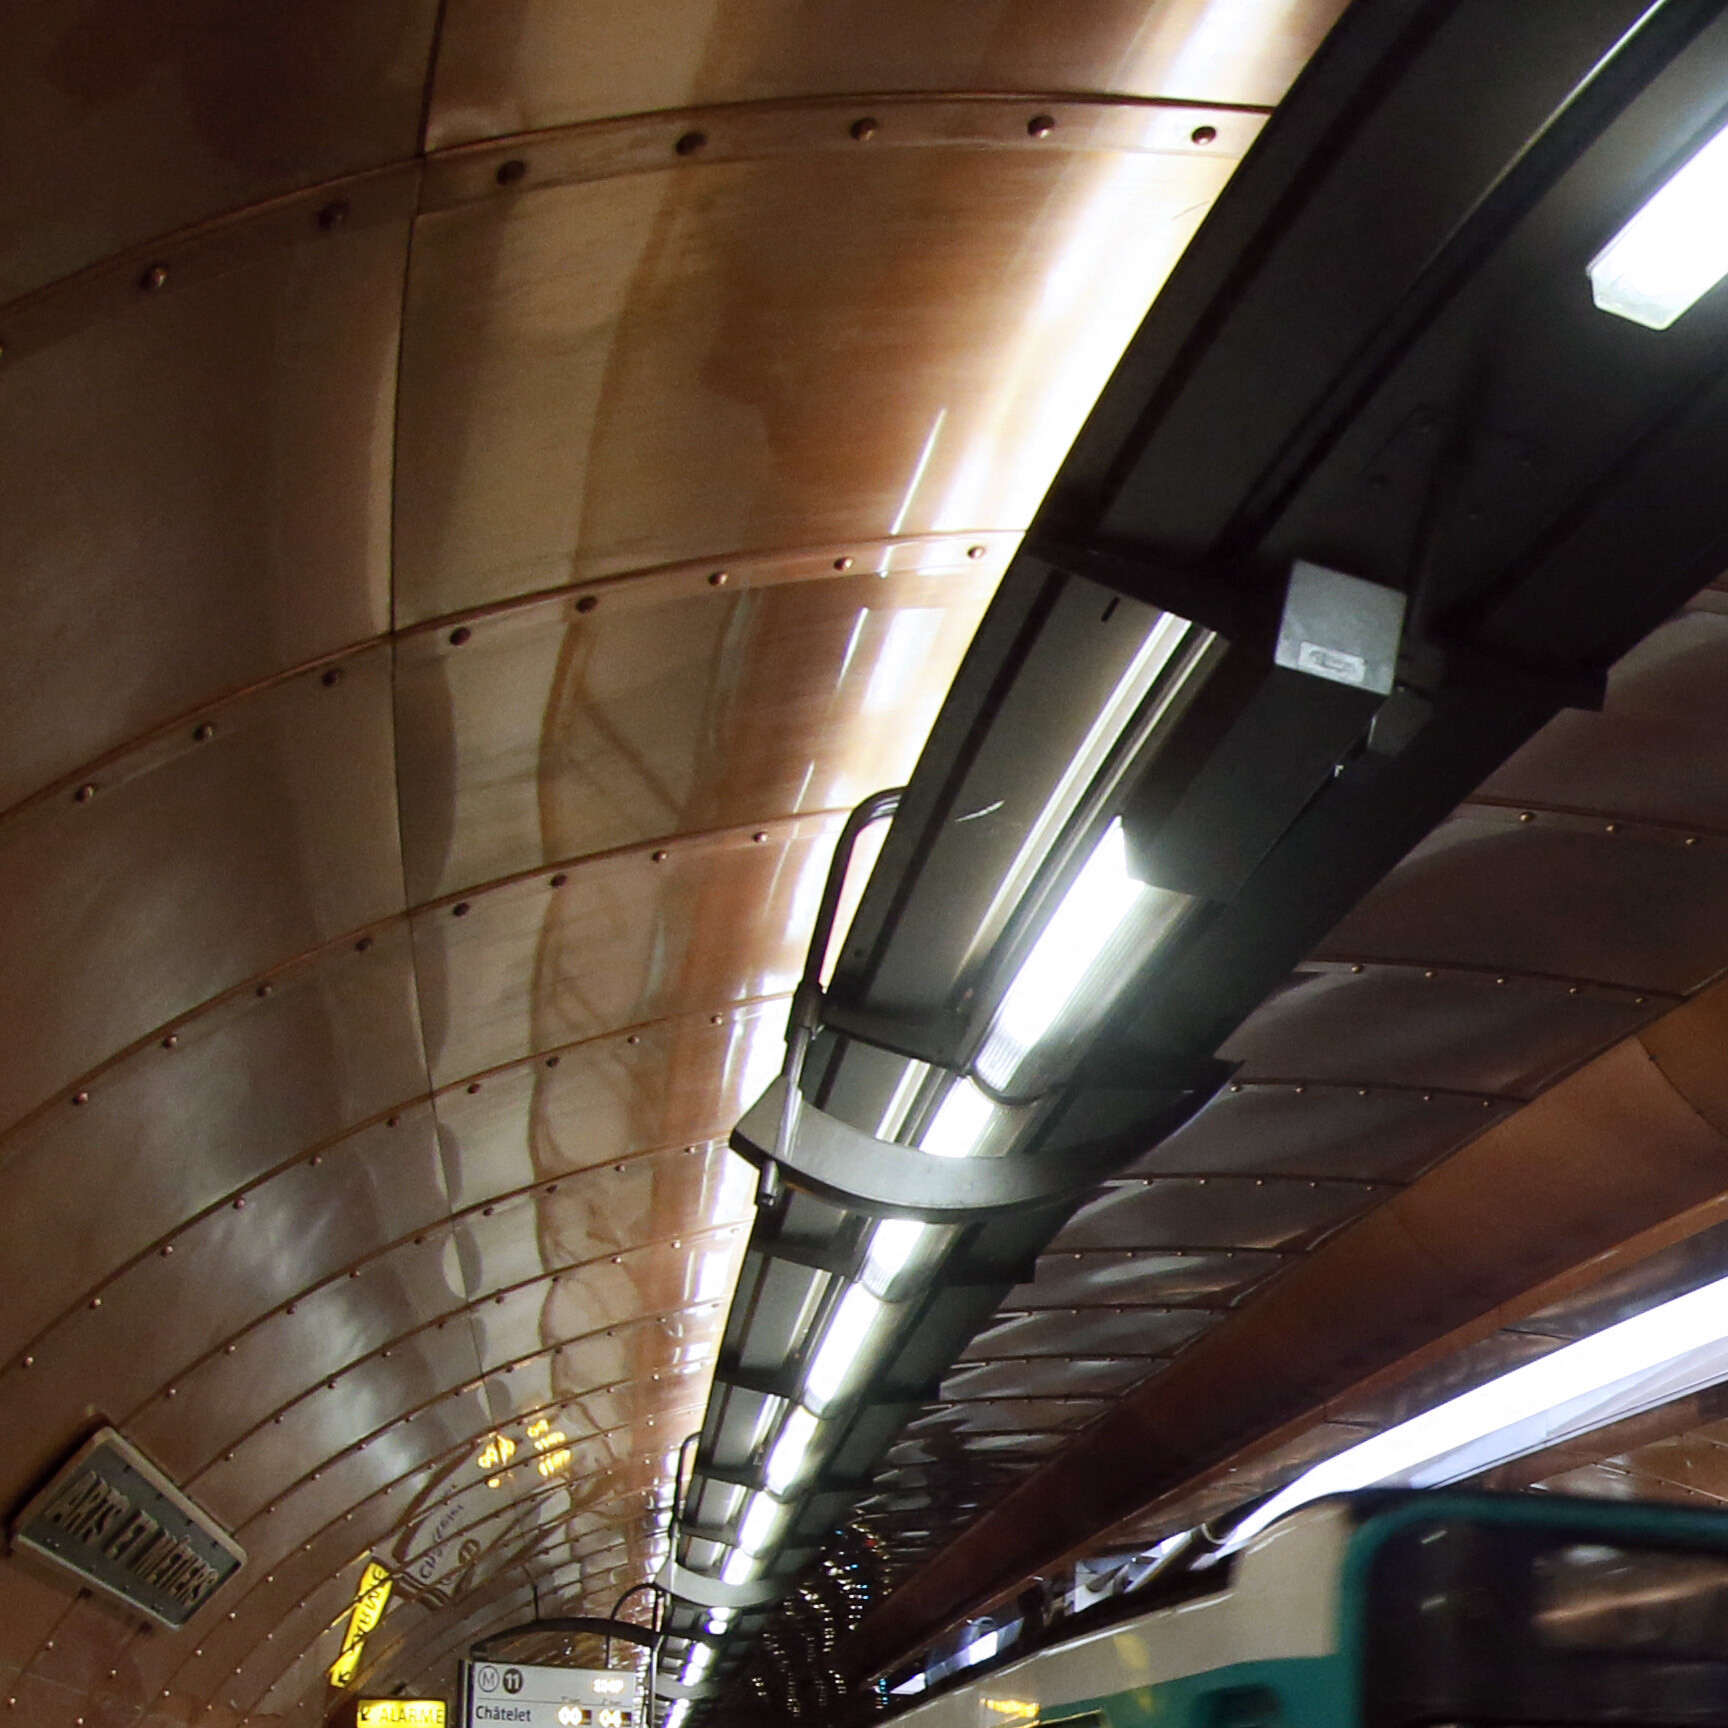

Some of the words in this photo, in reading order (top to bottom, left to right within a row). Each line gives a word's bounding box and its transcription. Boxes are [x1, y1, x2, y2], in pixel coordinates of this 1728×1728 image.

[44, 1470, 130, 1546] ARTS
[106, 1509, 158, 1561] ET
[380, 1708, 444, 1724] ALARME
[475, 1705, 531, 1722] Châtelet
